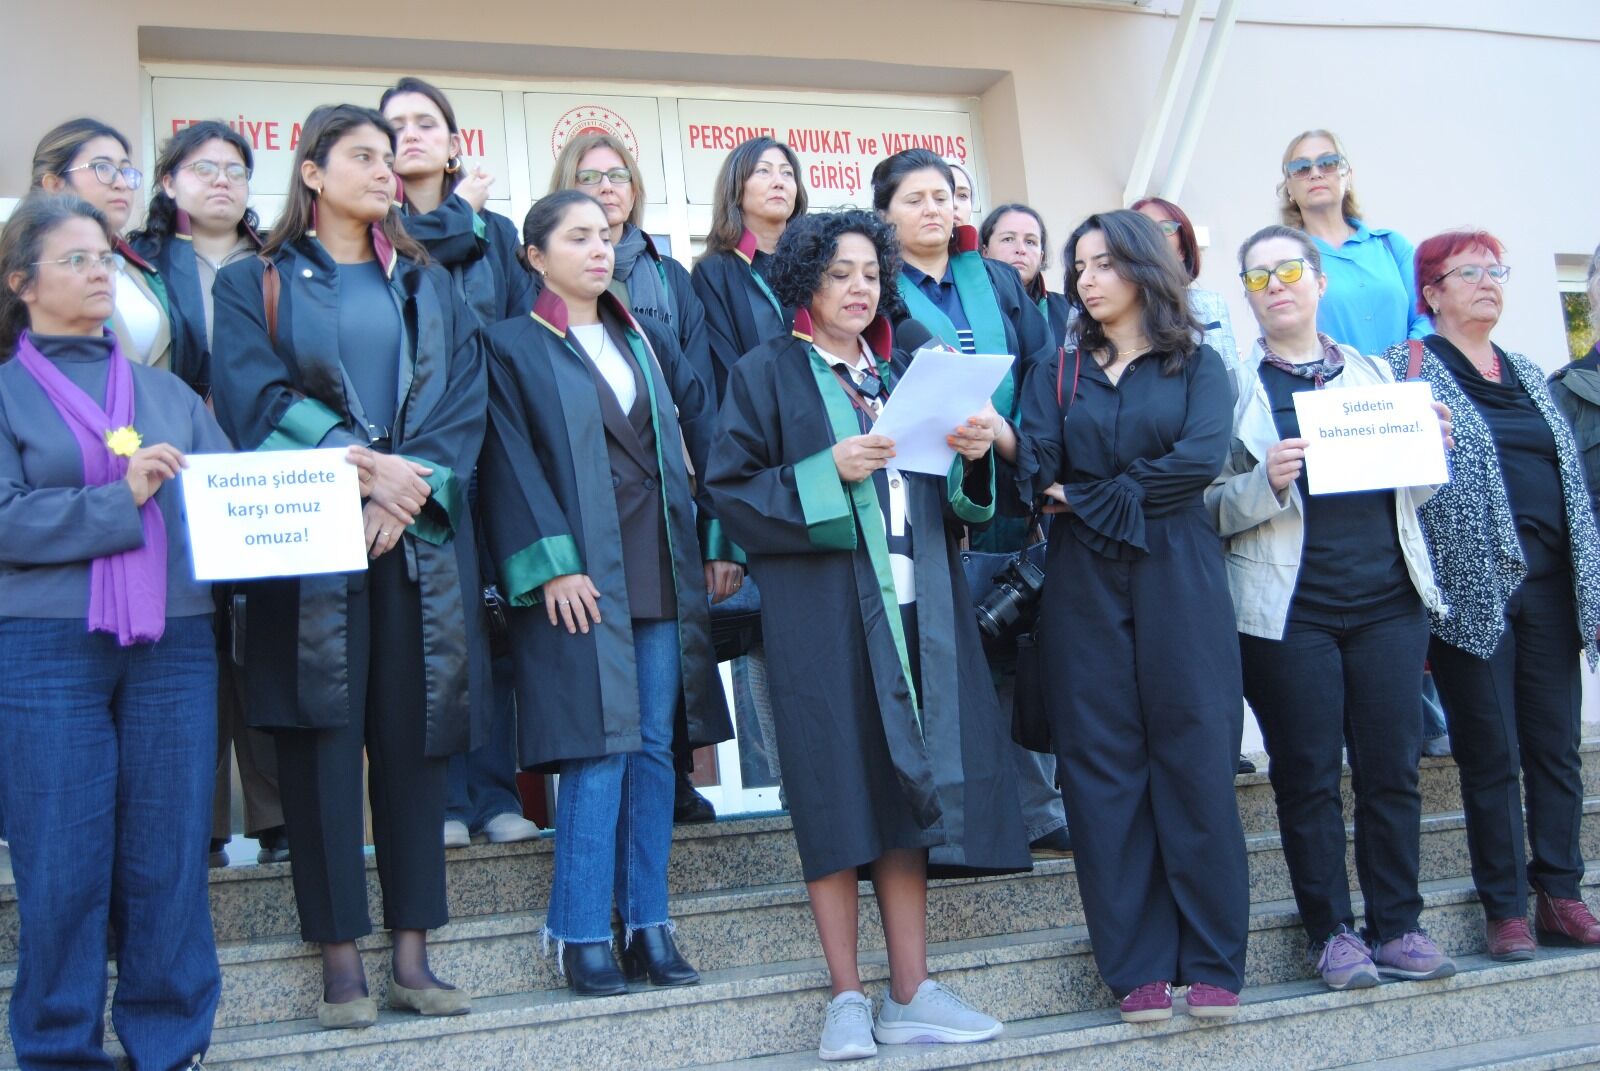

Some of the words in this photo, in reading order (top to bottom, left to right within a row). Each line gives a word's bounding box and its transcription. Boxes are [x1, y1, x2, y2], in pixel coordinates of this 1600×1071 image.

[172, 115, 280, 150] FİYE
[787, 128, 851, 154] AVUKAT
[857, 138, 878, 155] ve
[881, 132, 967, 165] VATANDAŞ
[809, 161, 862, 196] GİRİŞİ
[1342, 399, 1394, 416] Şiddetin
[1318, 423, 1375, 439] bahanesi
[1379, 420, 1424, 435] olmaz!.
[207, 473, 267, 489] Kadına
[272, 469, 336, 489] şiddete
[227, 502, 269, 519] karşı
[274, 501, 321, 515] omuz
[244, 527, 309, 546] omuza!
